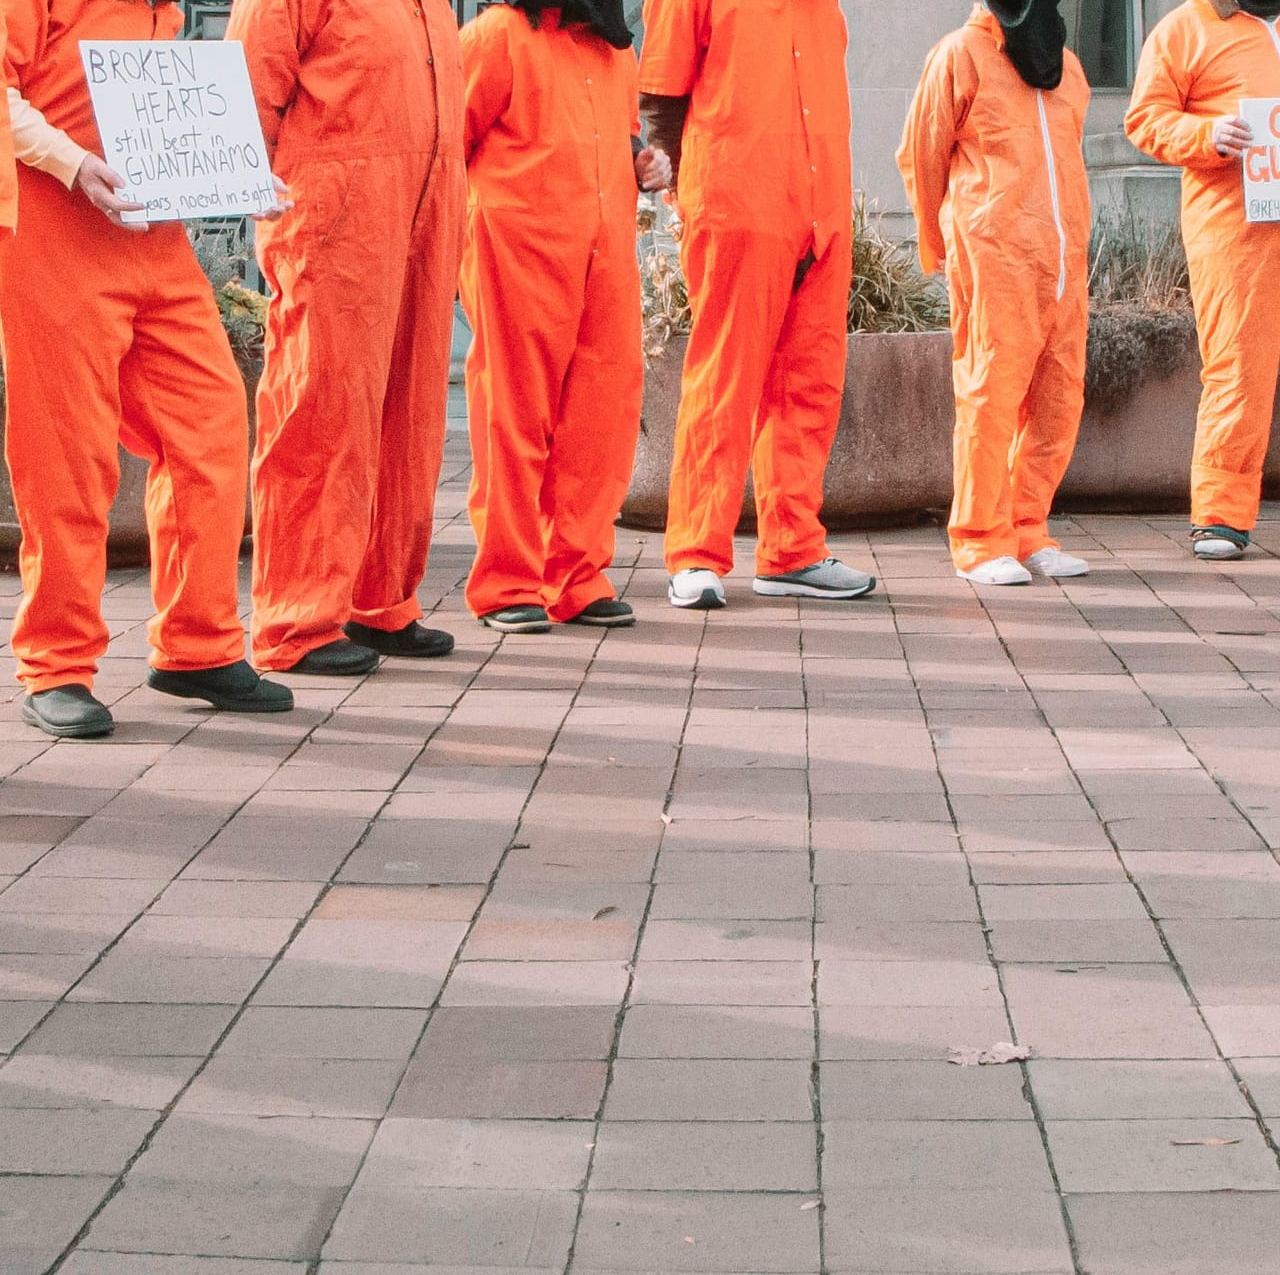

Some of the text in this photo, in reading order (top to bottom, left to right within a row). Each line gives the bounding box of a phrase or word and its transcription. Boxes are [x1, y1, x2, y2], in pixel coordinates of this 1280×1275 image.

[88, 46, 197, 86] BROKEN
[131, 83, 227, 125] HEARTS
[114, 125, 225, 153] still beat in
[125, 142, 260, 186] GUANTANAMO
[242, 180, 273, 212] sight
